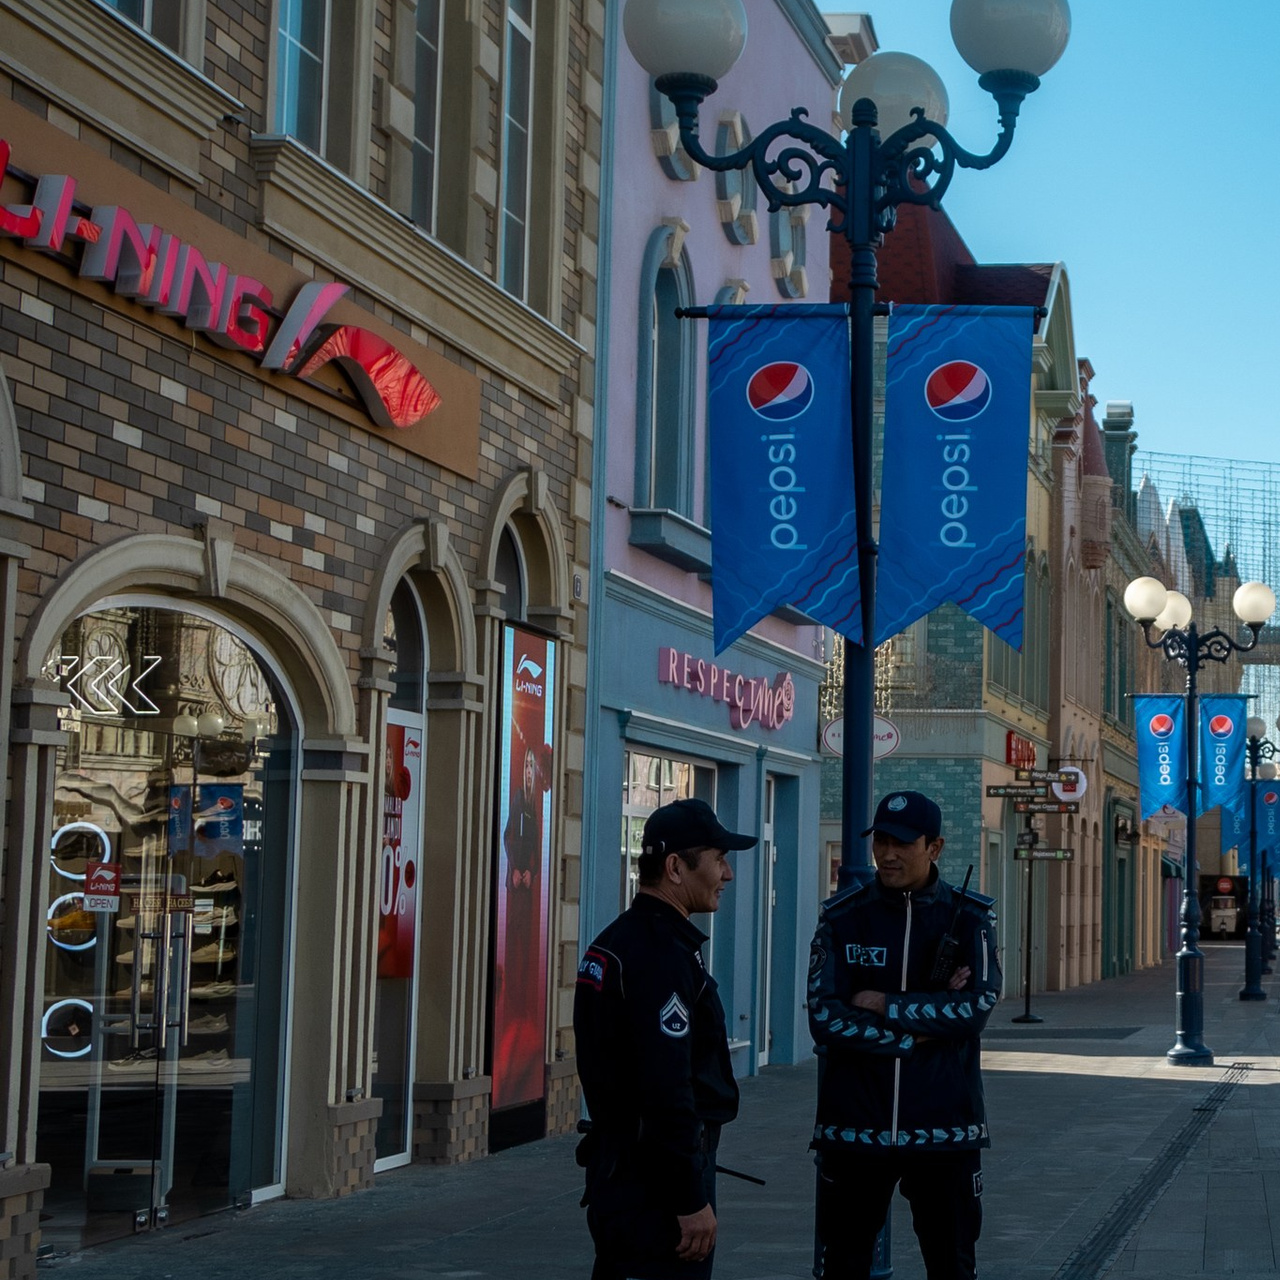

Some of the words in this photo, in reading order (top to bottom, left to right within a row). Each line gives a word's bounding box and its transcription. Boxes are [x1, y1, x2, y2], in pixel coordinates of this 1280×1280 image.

[761, 433, 807, 550] pepsi
[935, 434, 978, 548] pepsi
[515, 679, 543, 697] LI-NING
[669, 647, 757, 710] RESPECT
[1156, 741, 1173, 785] pepsi
[1213, 742, 1228, 785] pepsi
[89, 898, 114, 909] OPEN
[90, 882, 115, 892] LI-NING
